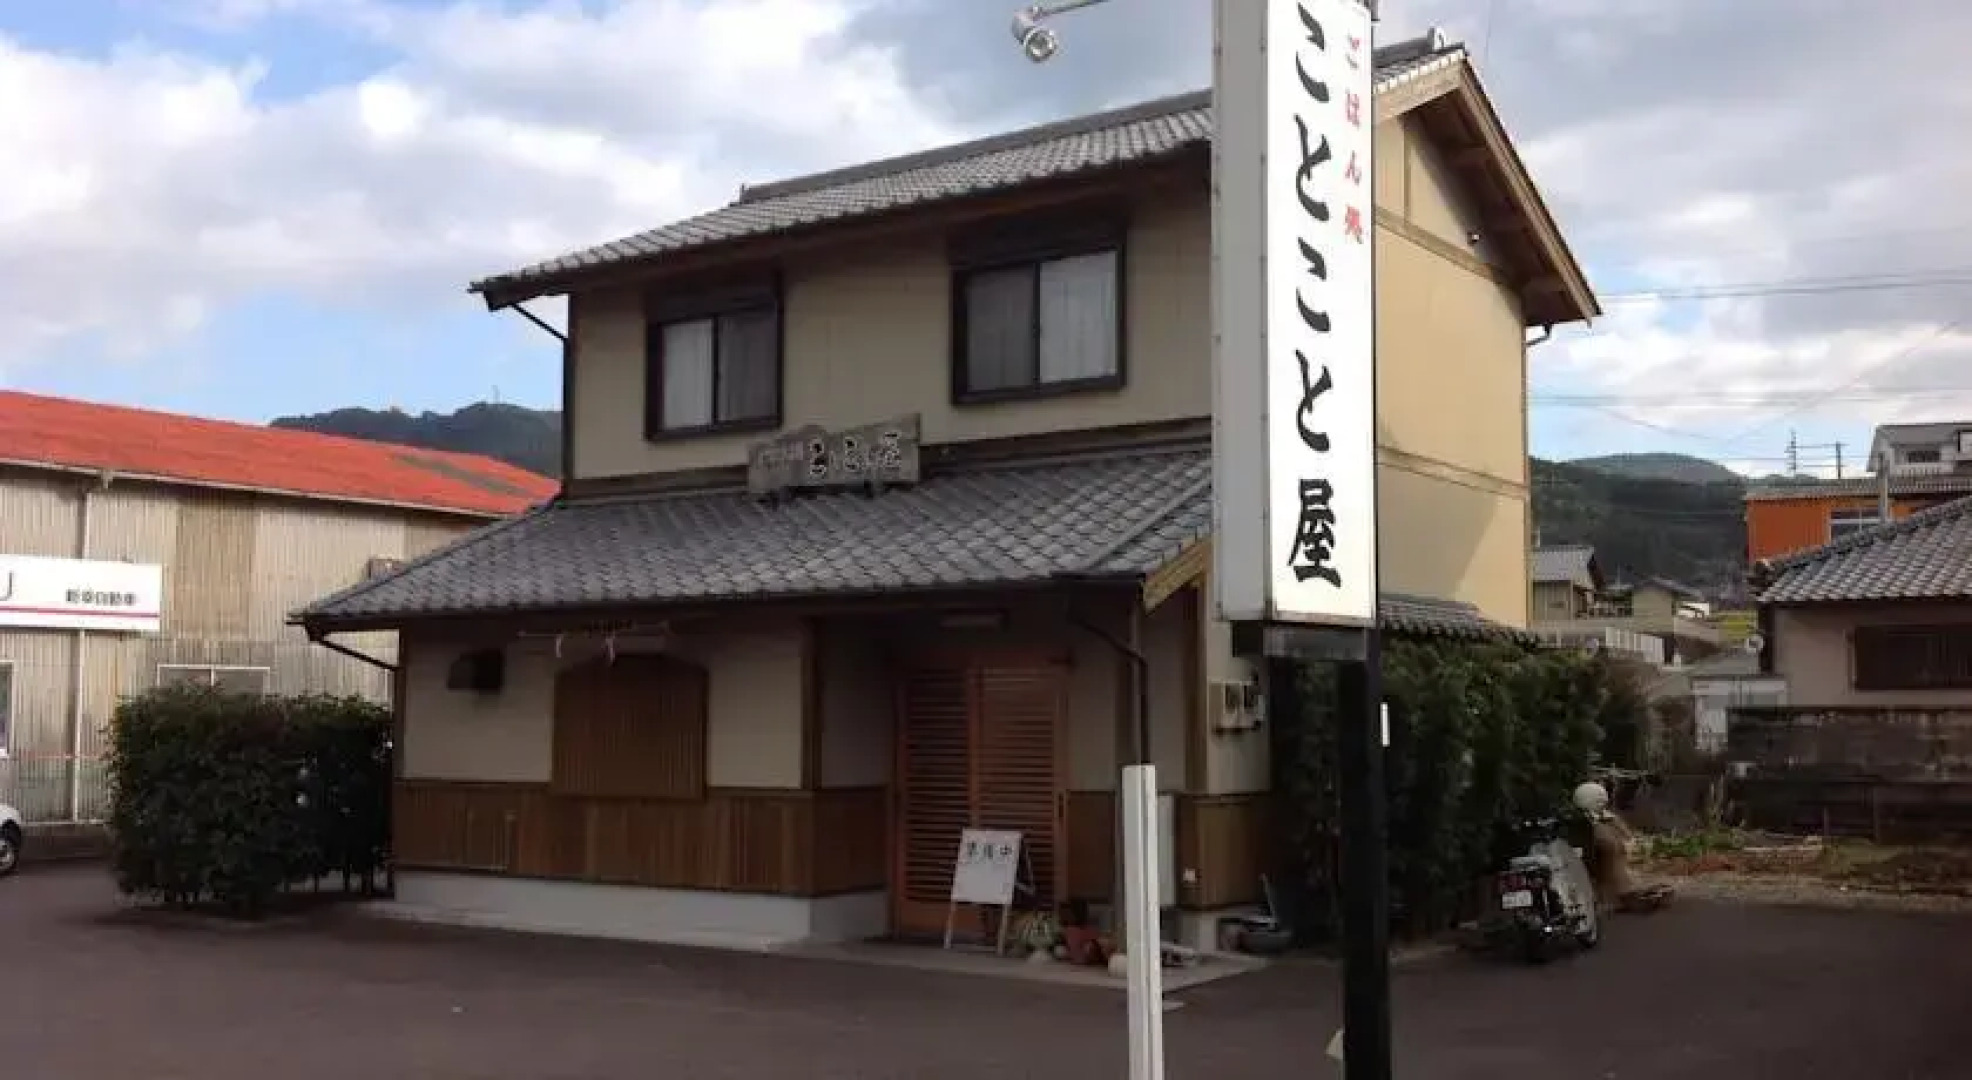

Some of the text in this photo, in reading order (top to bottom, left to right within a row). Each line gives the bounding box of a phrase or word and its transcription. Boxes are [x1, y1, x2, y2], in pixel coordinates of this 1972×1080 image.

[1287, 2, 1342, 588] ことこと屋
